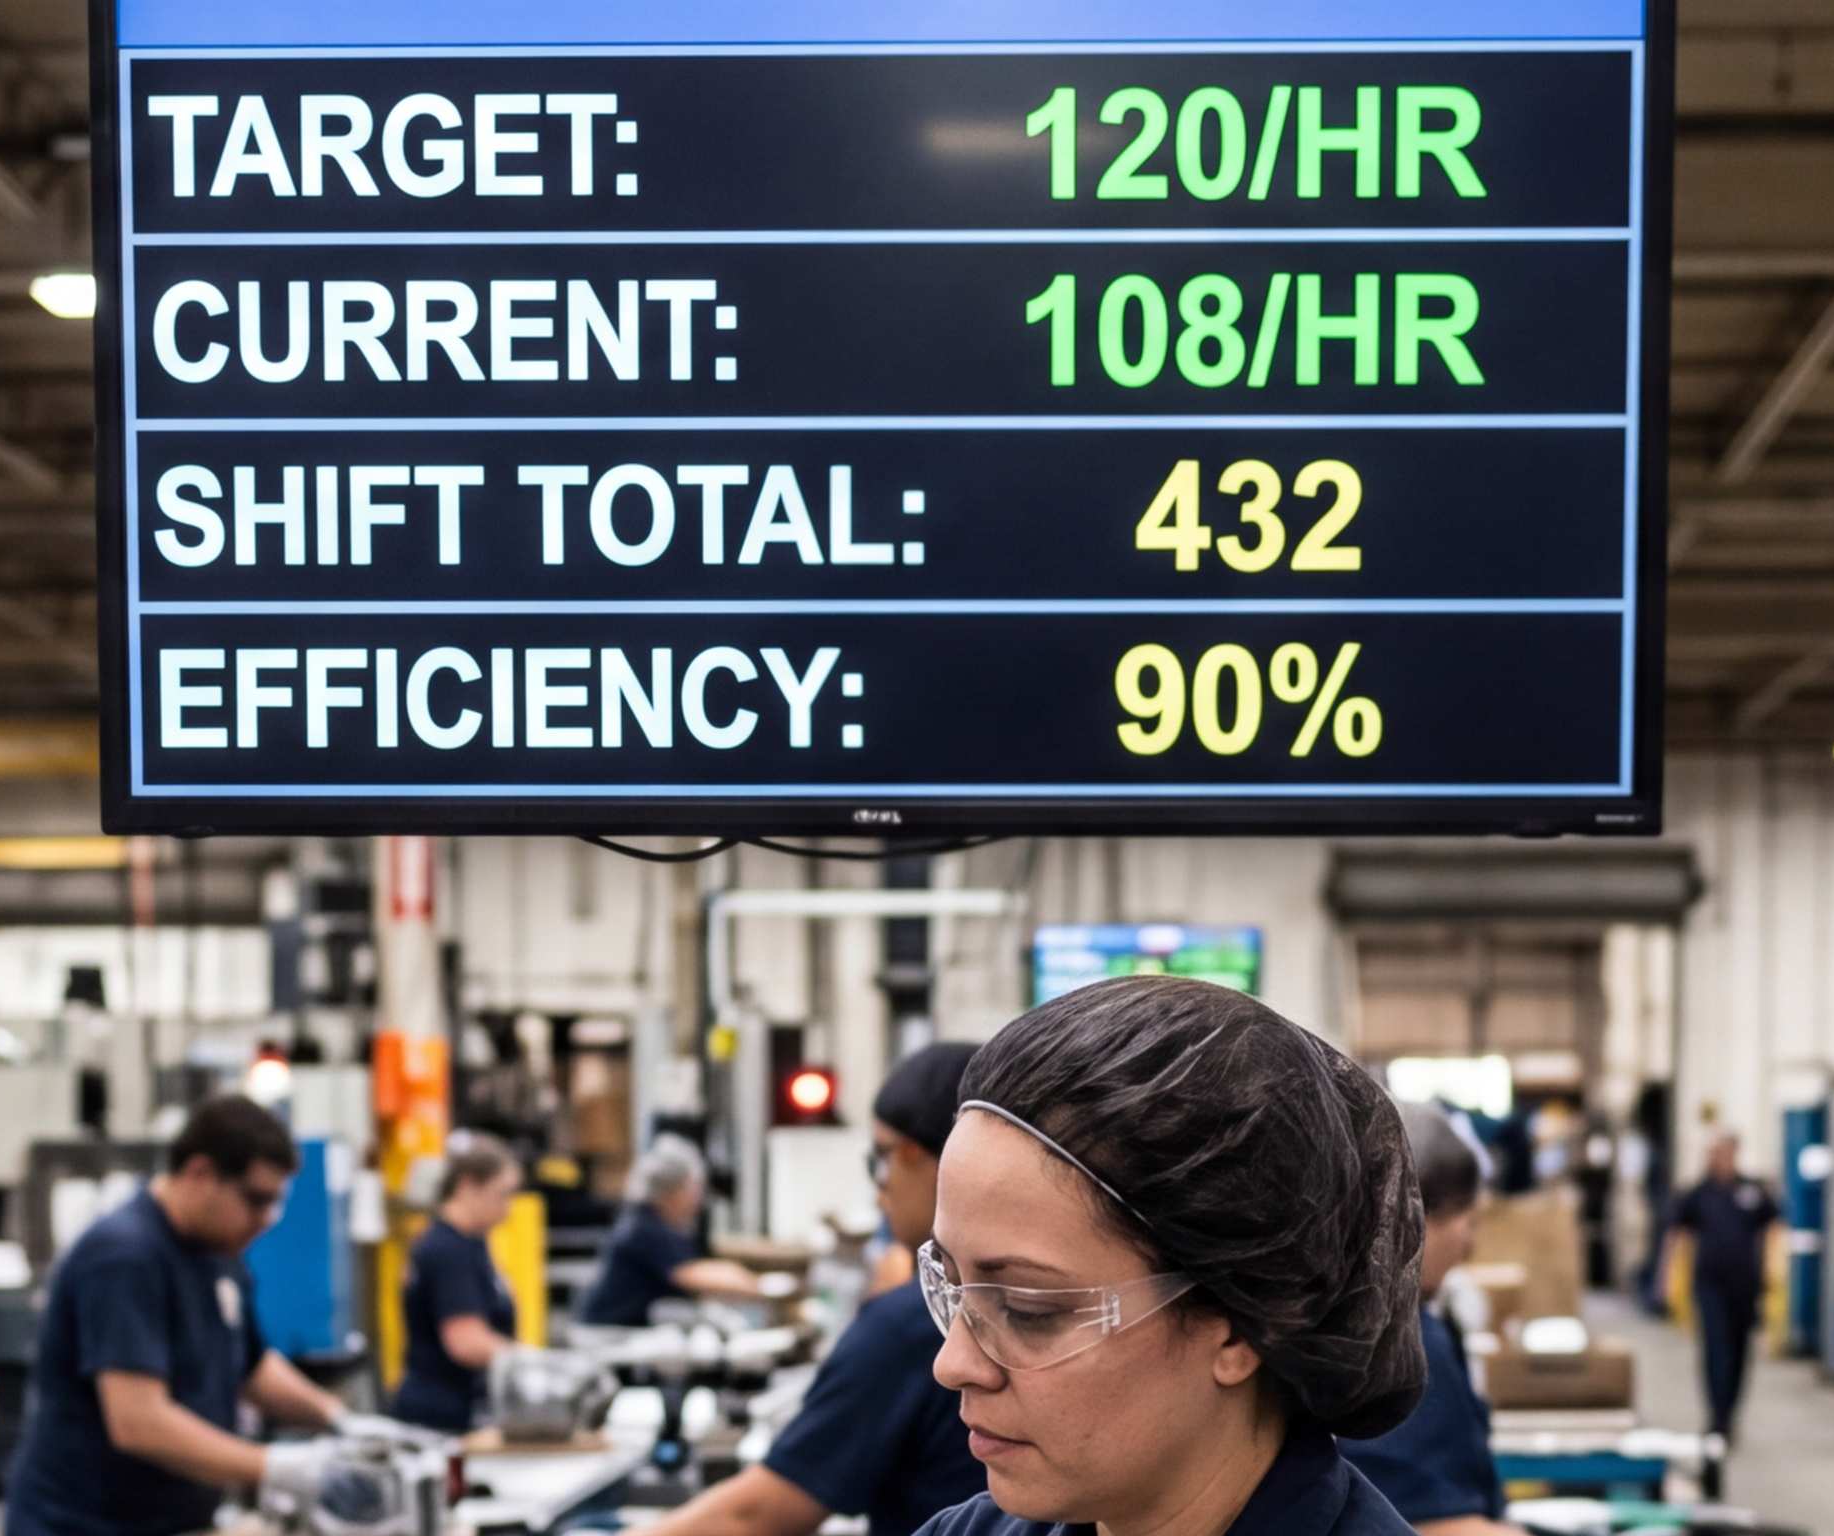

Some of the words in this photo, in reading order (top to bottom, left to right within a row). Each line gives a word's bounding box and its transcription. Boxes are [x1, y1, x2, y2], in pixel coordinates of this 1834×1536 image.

[148, 92, 638, 198] TARGET:
[1025, 85, 1487, 201] 120/HR
[153, 279, 738, 384] CURRENT:
[1026, 272, 1485, 388] 108/HR
[154, 464, 485, 568] SHIFT
[518, 464, 925, 567] TOTAL:
[1135, 459, 1362, 573] 432
[159, 646, 864, 750] EFFICIENCY:
[1115, 642, 1382, 757] 90%
